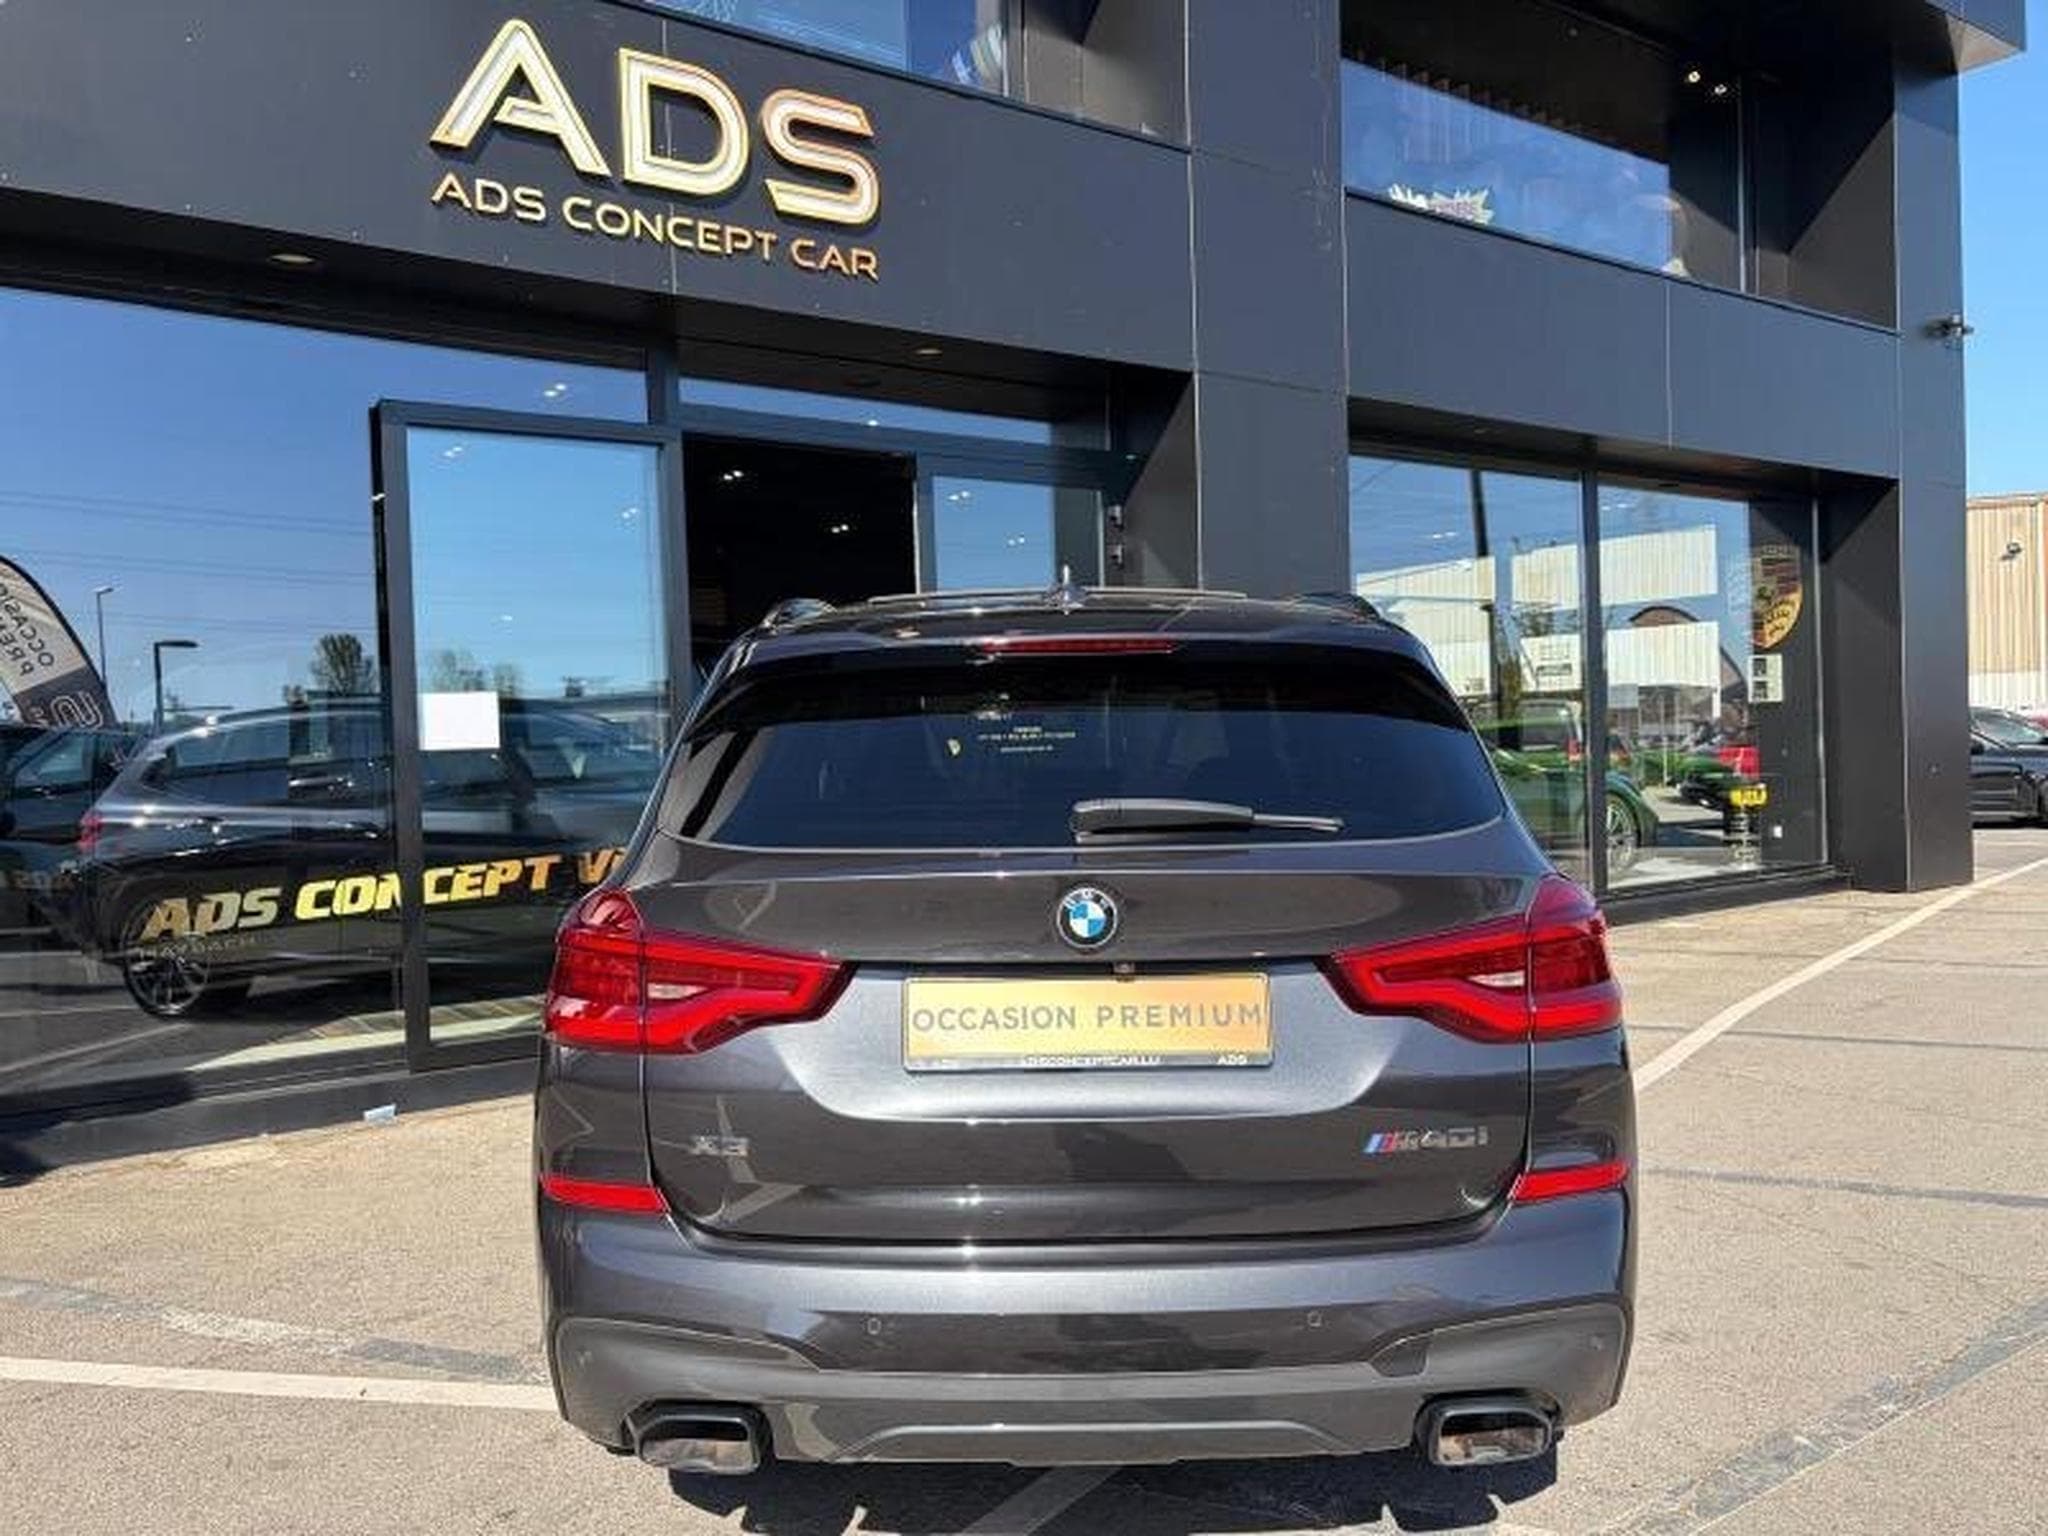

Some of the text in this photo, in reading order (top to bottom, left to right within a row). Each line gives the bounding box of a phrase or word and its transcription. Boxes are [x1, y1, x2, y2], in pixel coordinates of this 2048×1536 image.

[429, 18, 880, 226] ADS
[432, 172, 879, 281] ADS CONCEPT CAR
[140, 886, 282, 943] ADS
[912, 1003, 1262, 1032] OCCASION PREMIUM
